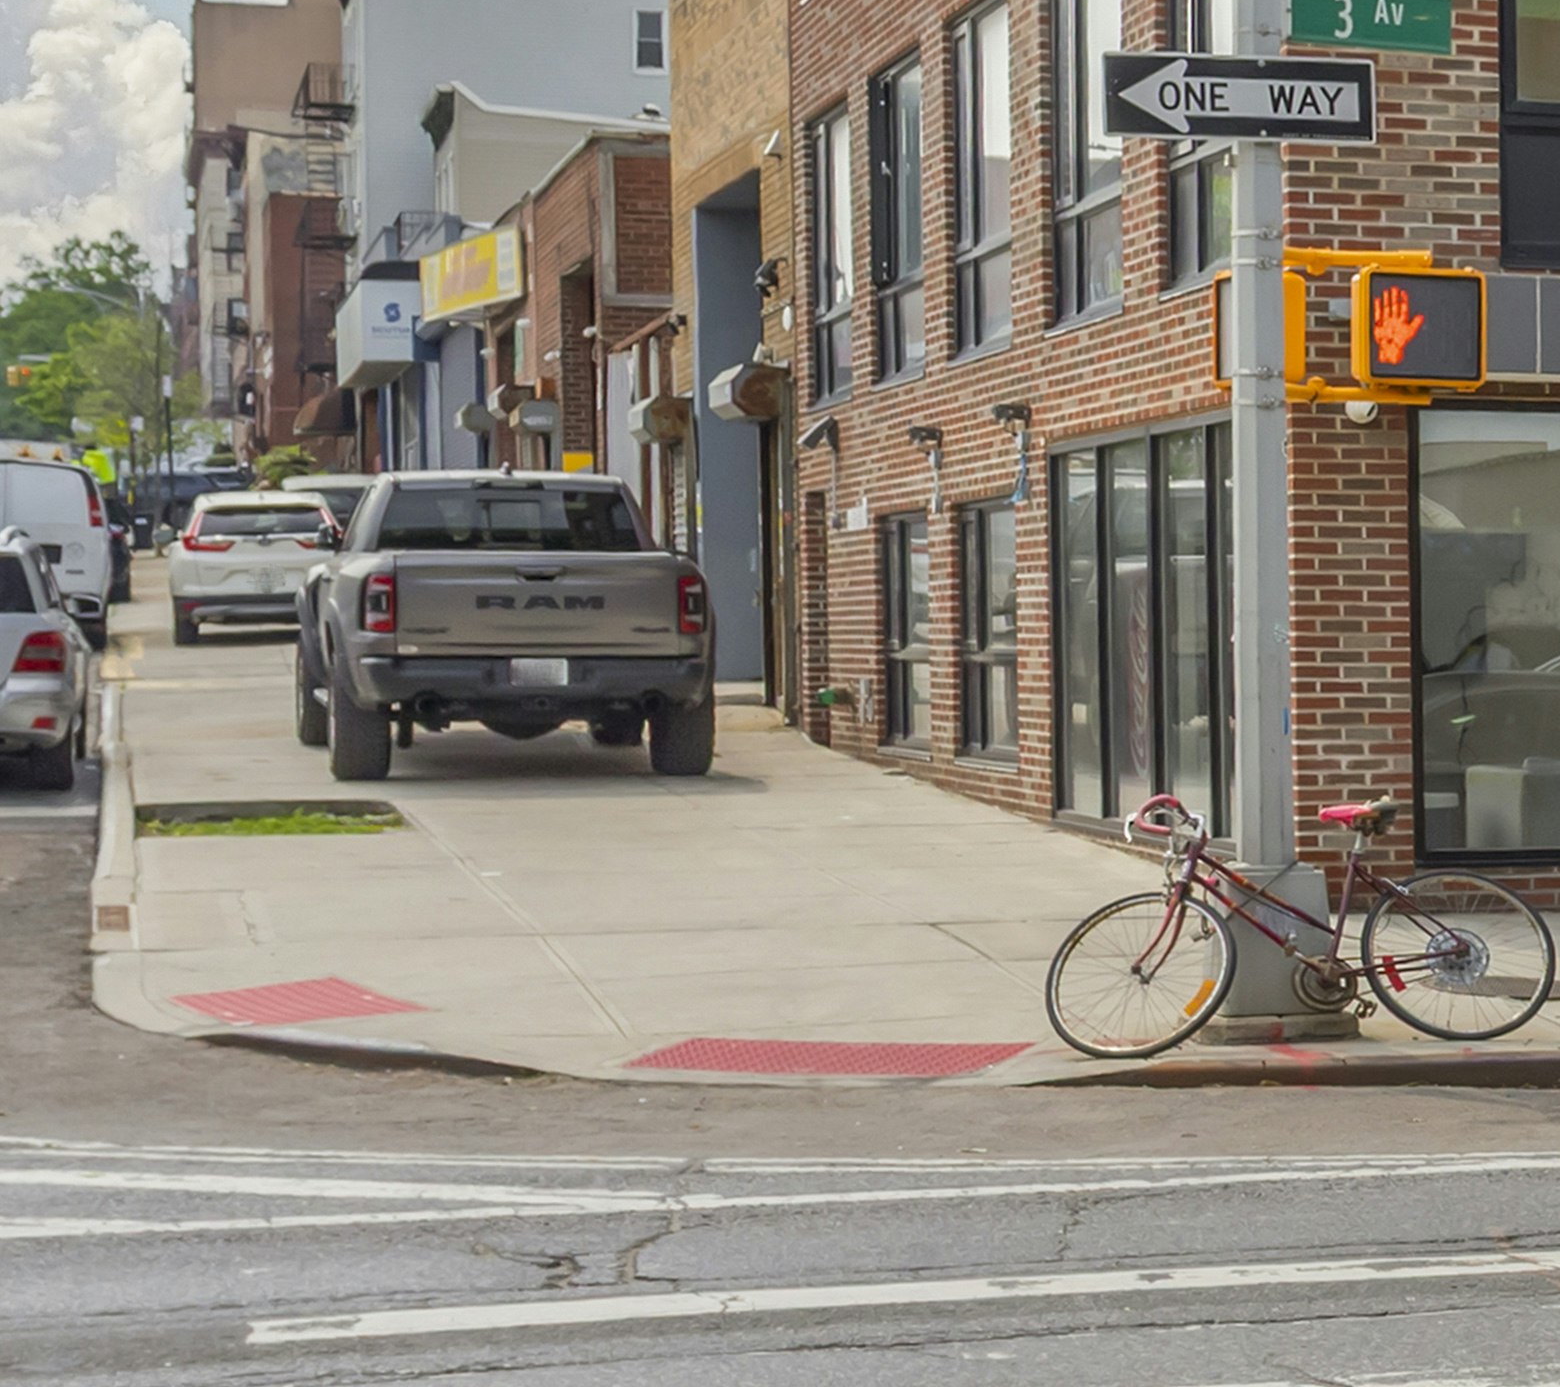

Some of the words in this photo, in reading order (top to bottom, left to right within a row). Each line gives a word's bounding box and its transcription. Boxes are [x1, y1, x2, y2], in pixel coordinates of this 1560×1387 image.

[1158, 81, 1230, 112] ONE
[1269, 84, 1344, 116] WAY
[476, 595, 605, 610] RAM
